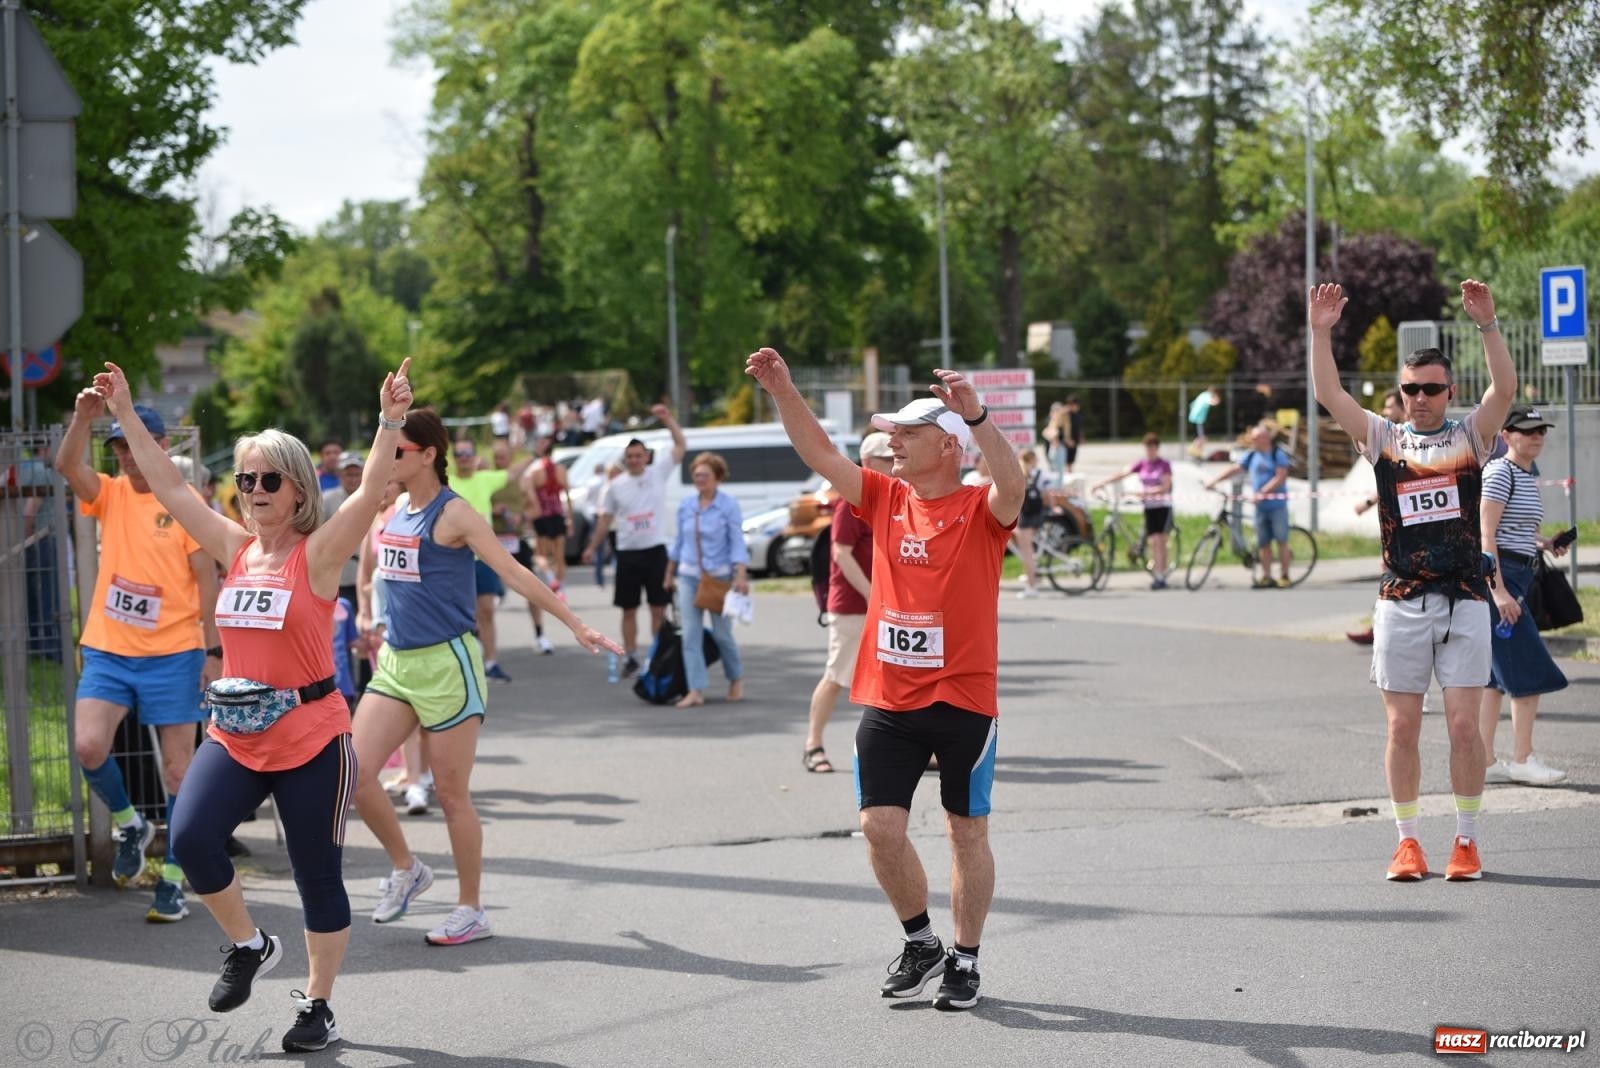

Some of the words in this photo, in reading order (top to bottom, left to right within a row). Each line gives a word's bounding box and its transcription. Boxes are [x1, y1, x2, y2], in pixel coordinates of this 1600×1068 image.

[1549, 275, 1576, 332] P
[1409, 490, 1448, 512] 150
[384, 548, 407, 569] 176
[115, 591, 148, 615] 154
[233, 590, 273, 613] 175
[888, 626, 928, 652] 162
